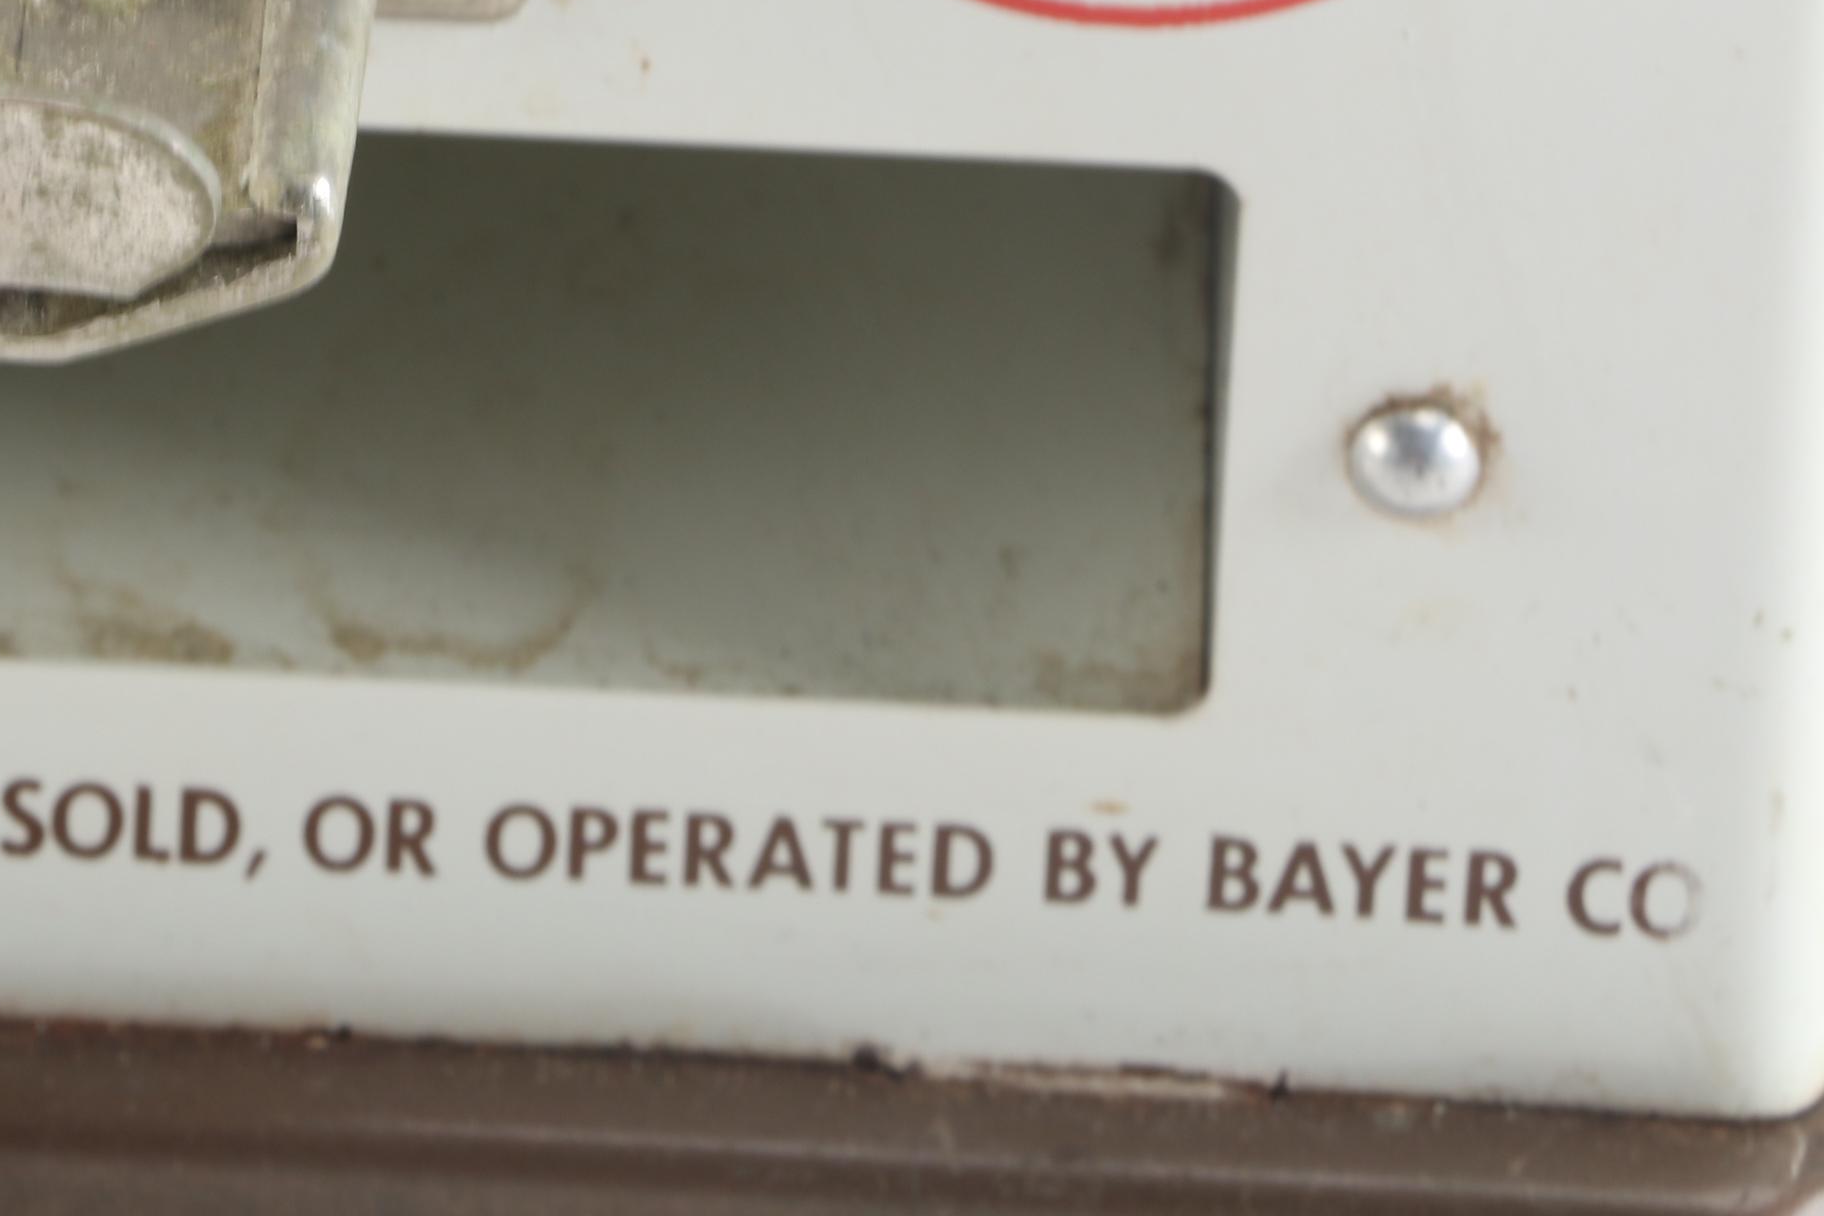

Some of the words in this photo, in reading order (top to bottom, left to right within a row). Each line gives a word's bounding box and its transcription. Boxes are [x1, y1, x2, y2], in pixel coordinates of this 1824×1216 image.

[300, 792, 438, 880] OR
[482, 801, 996, 901] OPERATED
[1041, 826, 1160, 909] BY
[1204, 832, 1520, 931] BAYER
[1564, 856, 1704, 942] CO
